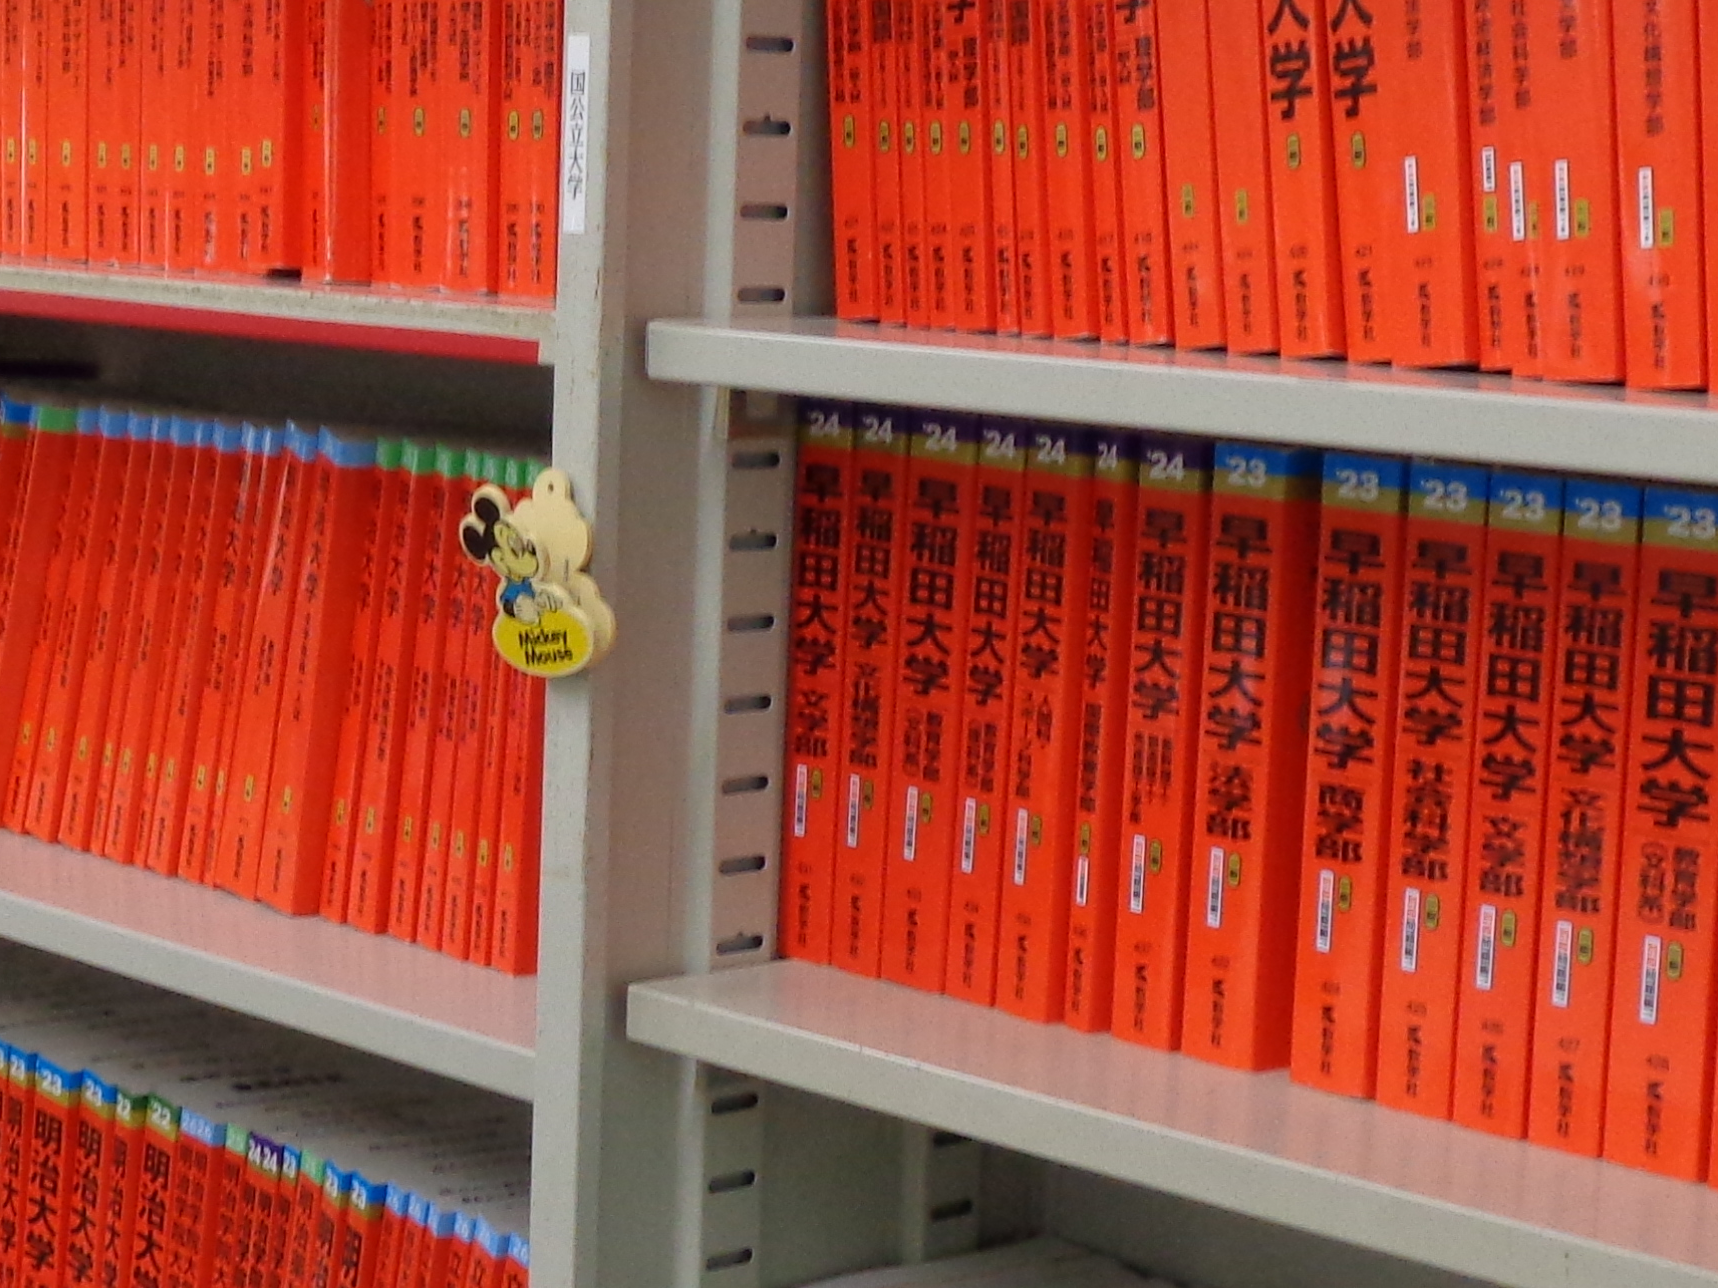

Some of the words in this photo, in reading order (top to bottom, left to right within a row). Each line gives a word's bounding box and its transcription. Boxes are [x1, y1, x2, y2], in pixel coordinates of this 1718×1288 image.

[567, 72, 585, 200] 国公立大学
[518, 629, 569, 649] Mickey
[524, 646, 574, 666] Mouse
[1205, 517, 1272, 751] 早稲田大学
[1314, 531, 1386, 770] 早稲田大学
[1403, 538, 1470, 747] 早稲田大学
[1478, 550, 1548, 801] 早稲田大学
[1557, 559, 1623, 775] 早稲田大学
[24, 1109, 63, 1272] 明治大学
